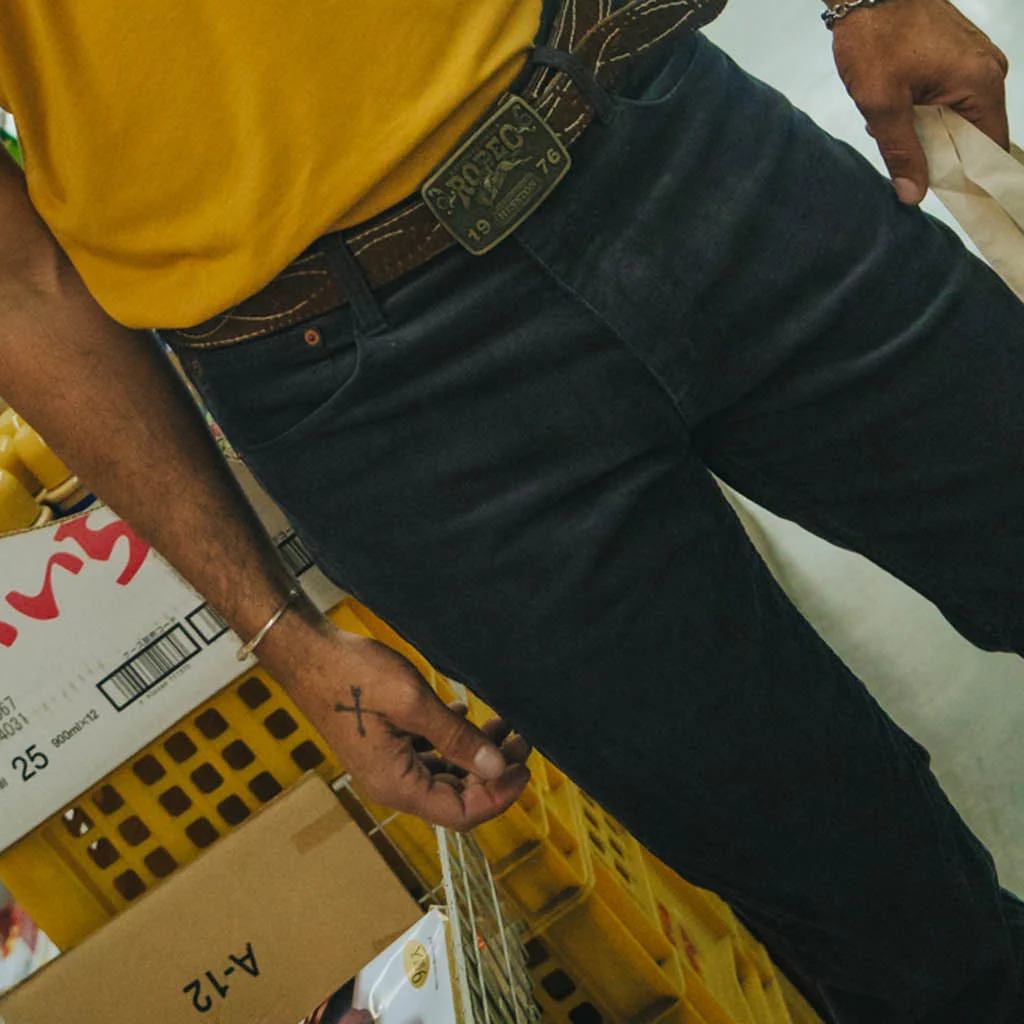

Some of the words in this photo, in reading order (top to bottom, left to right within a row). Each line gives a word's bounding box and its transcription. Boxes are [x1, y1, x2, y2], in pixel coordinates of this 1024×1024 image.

[468, 219, 491, 241] 19
[535, 148, 561, 174] 76
[11, 743, 49, 782] 25
[183, 941, 260, 1013] A-12
